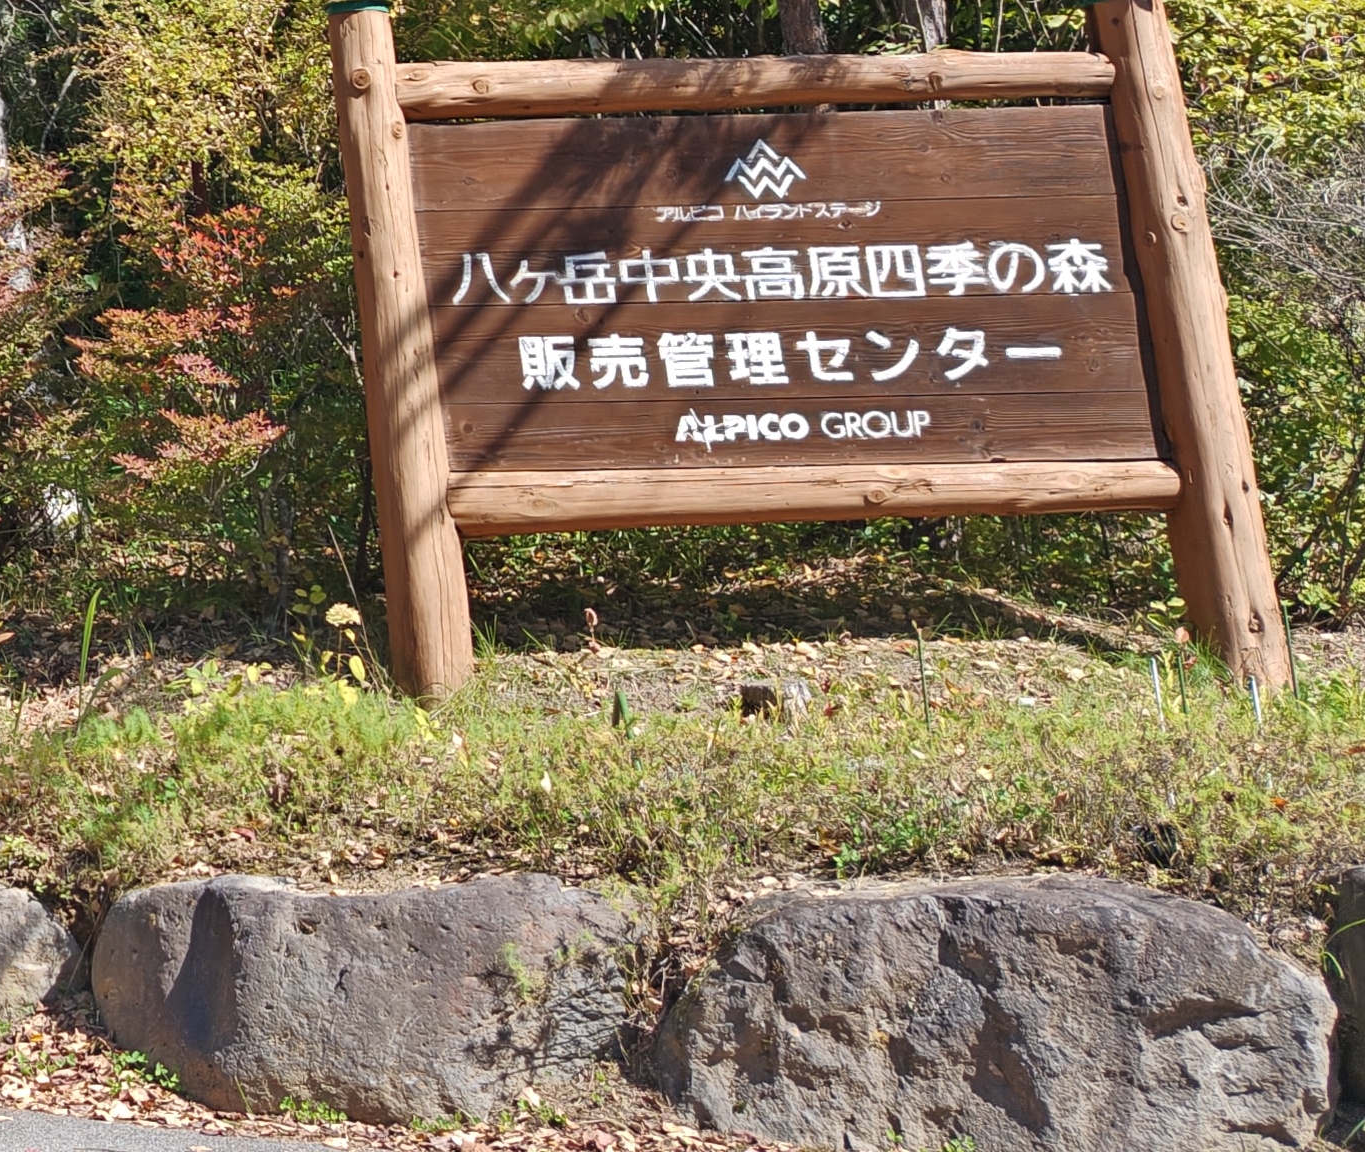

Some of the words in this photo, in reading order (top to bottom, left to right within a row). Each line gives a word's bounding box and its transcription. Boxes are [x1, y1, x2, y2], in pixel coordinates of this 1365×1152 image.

[517, 328, 1063, 391] 販売管理センター
[675, 407, 810, 452] ALPICO
[820, 410, 931, 440] GROUP
